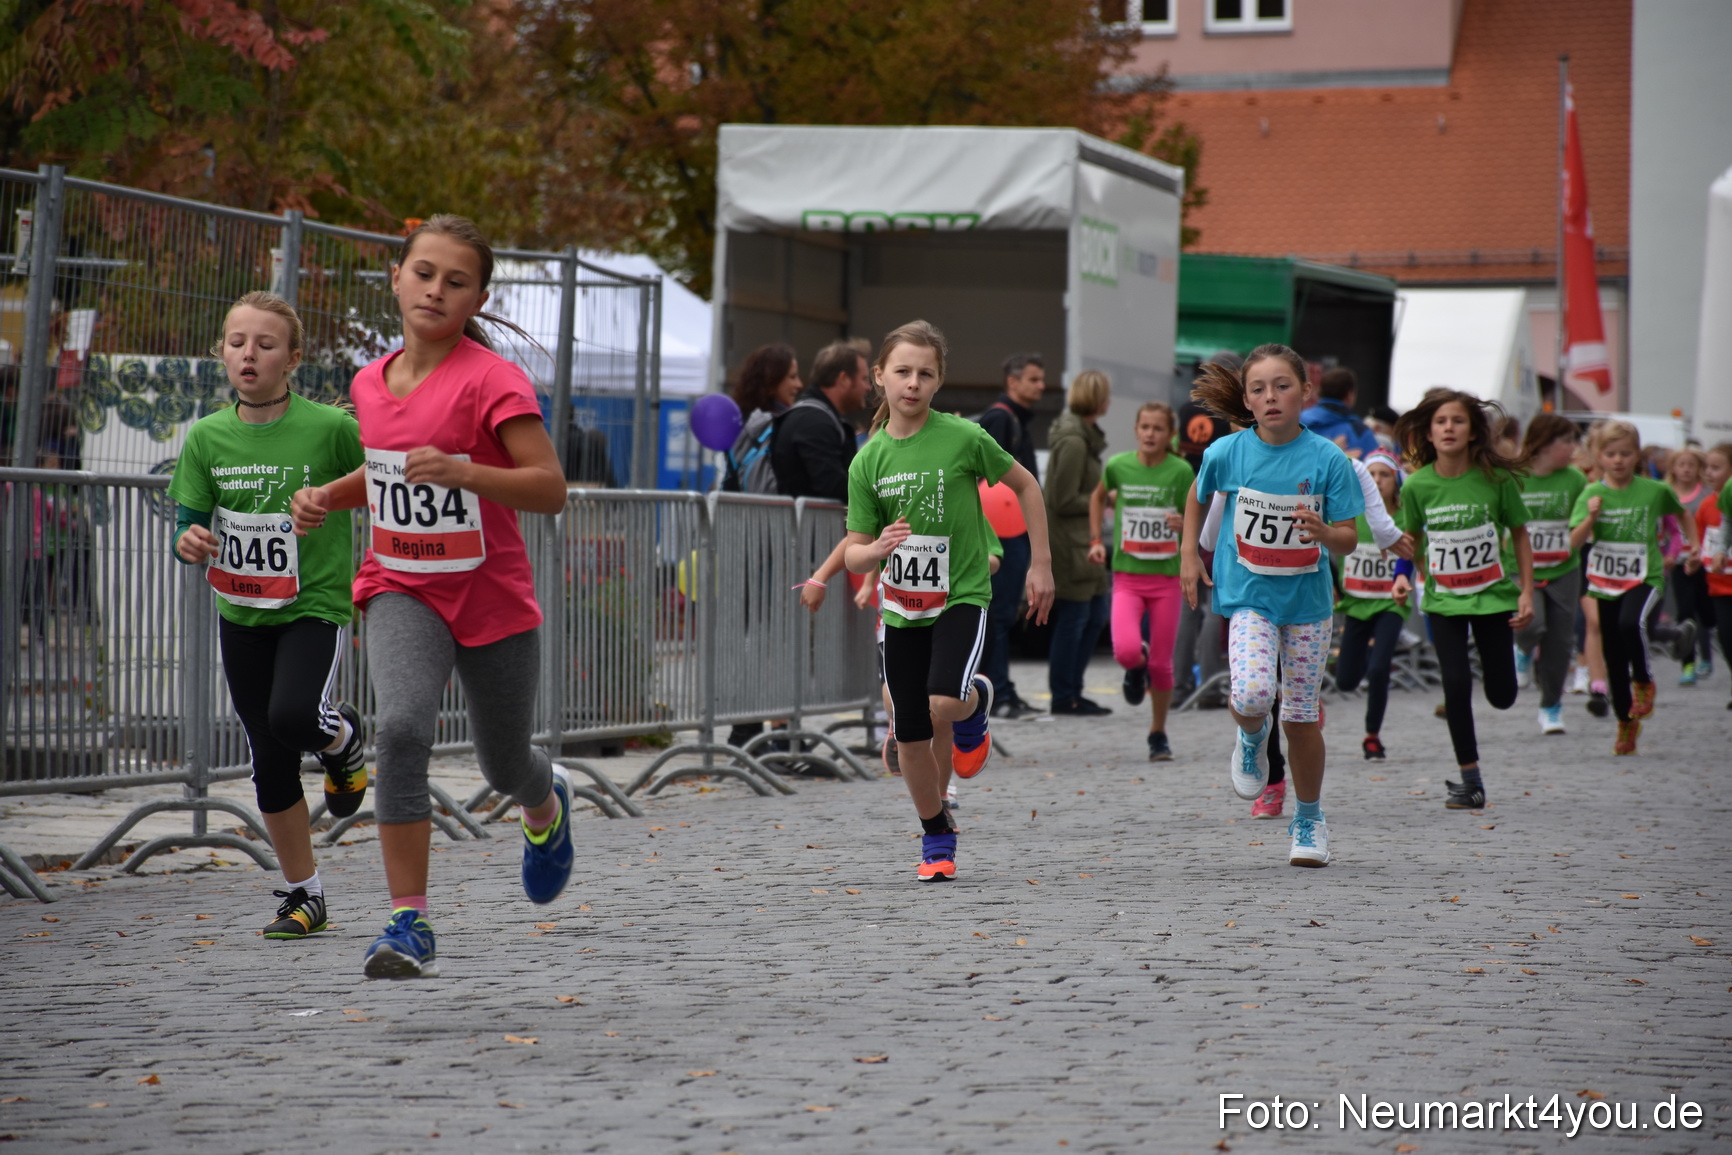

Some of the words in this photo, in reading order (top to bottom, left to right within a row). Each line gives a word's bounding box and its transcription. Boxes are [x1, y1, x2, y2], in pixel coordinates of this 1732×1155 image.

[210, 463, 279, 477] Neumarkter
[366, 460, 391, 475] ARTL
[372, 478, 468, 528] 7034
[937, 468, 945, 523] BAMBINI
[1238, 495, 1266, 509] PARTL
[1268, 502, 1311, 512] Neumakt
[217, 514, 230, 528] RTL
[230, 520, 277, 533] Neumarkt
[1128, 519, 1173, 540] 7085
[219, 529, 288, 572] 7046
[392, 536, 446, 560] Regina
[1532, 531, 1564, 550] 071
[1435, 541, 1494, 571] 7122
[1593, 553, 1641, 577] 7054
[888, 553, 941, 587] 044
[231, 578, 262, 594] Lena
